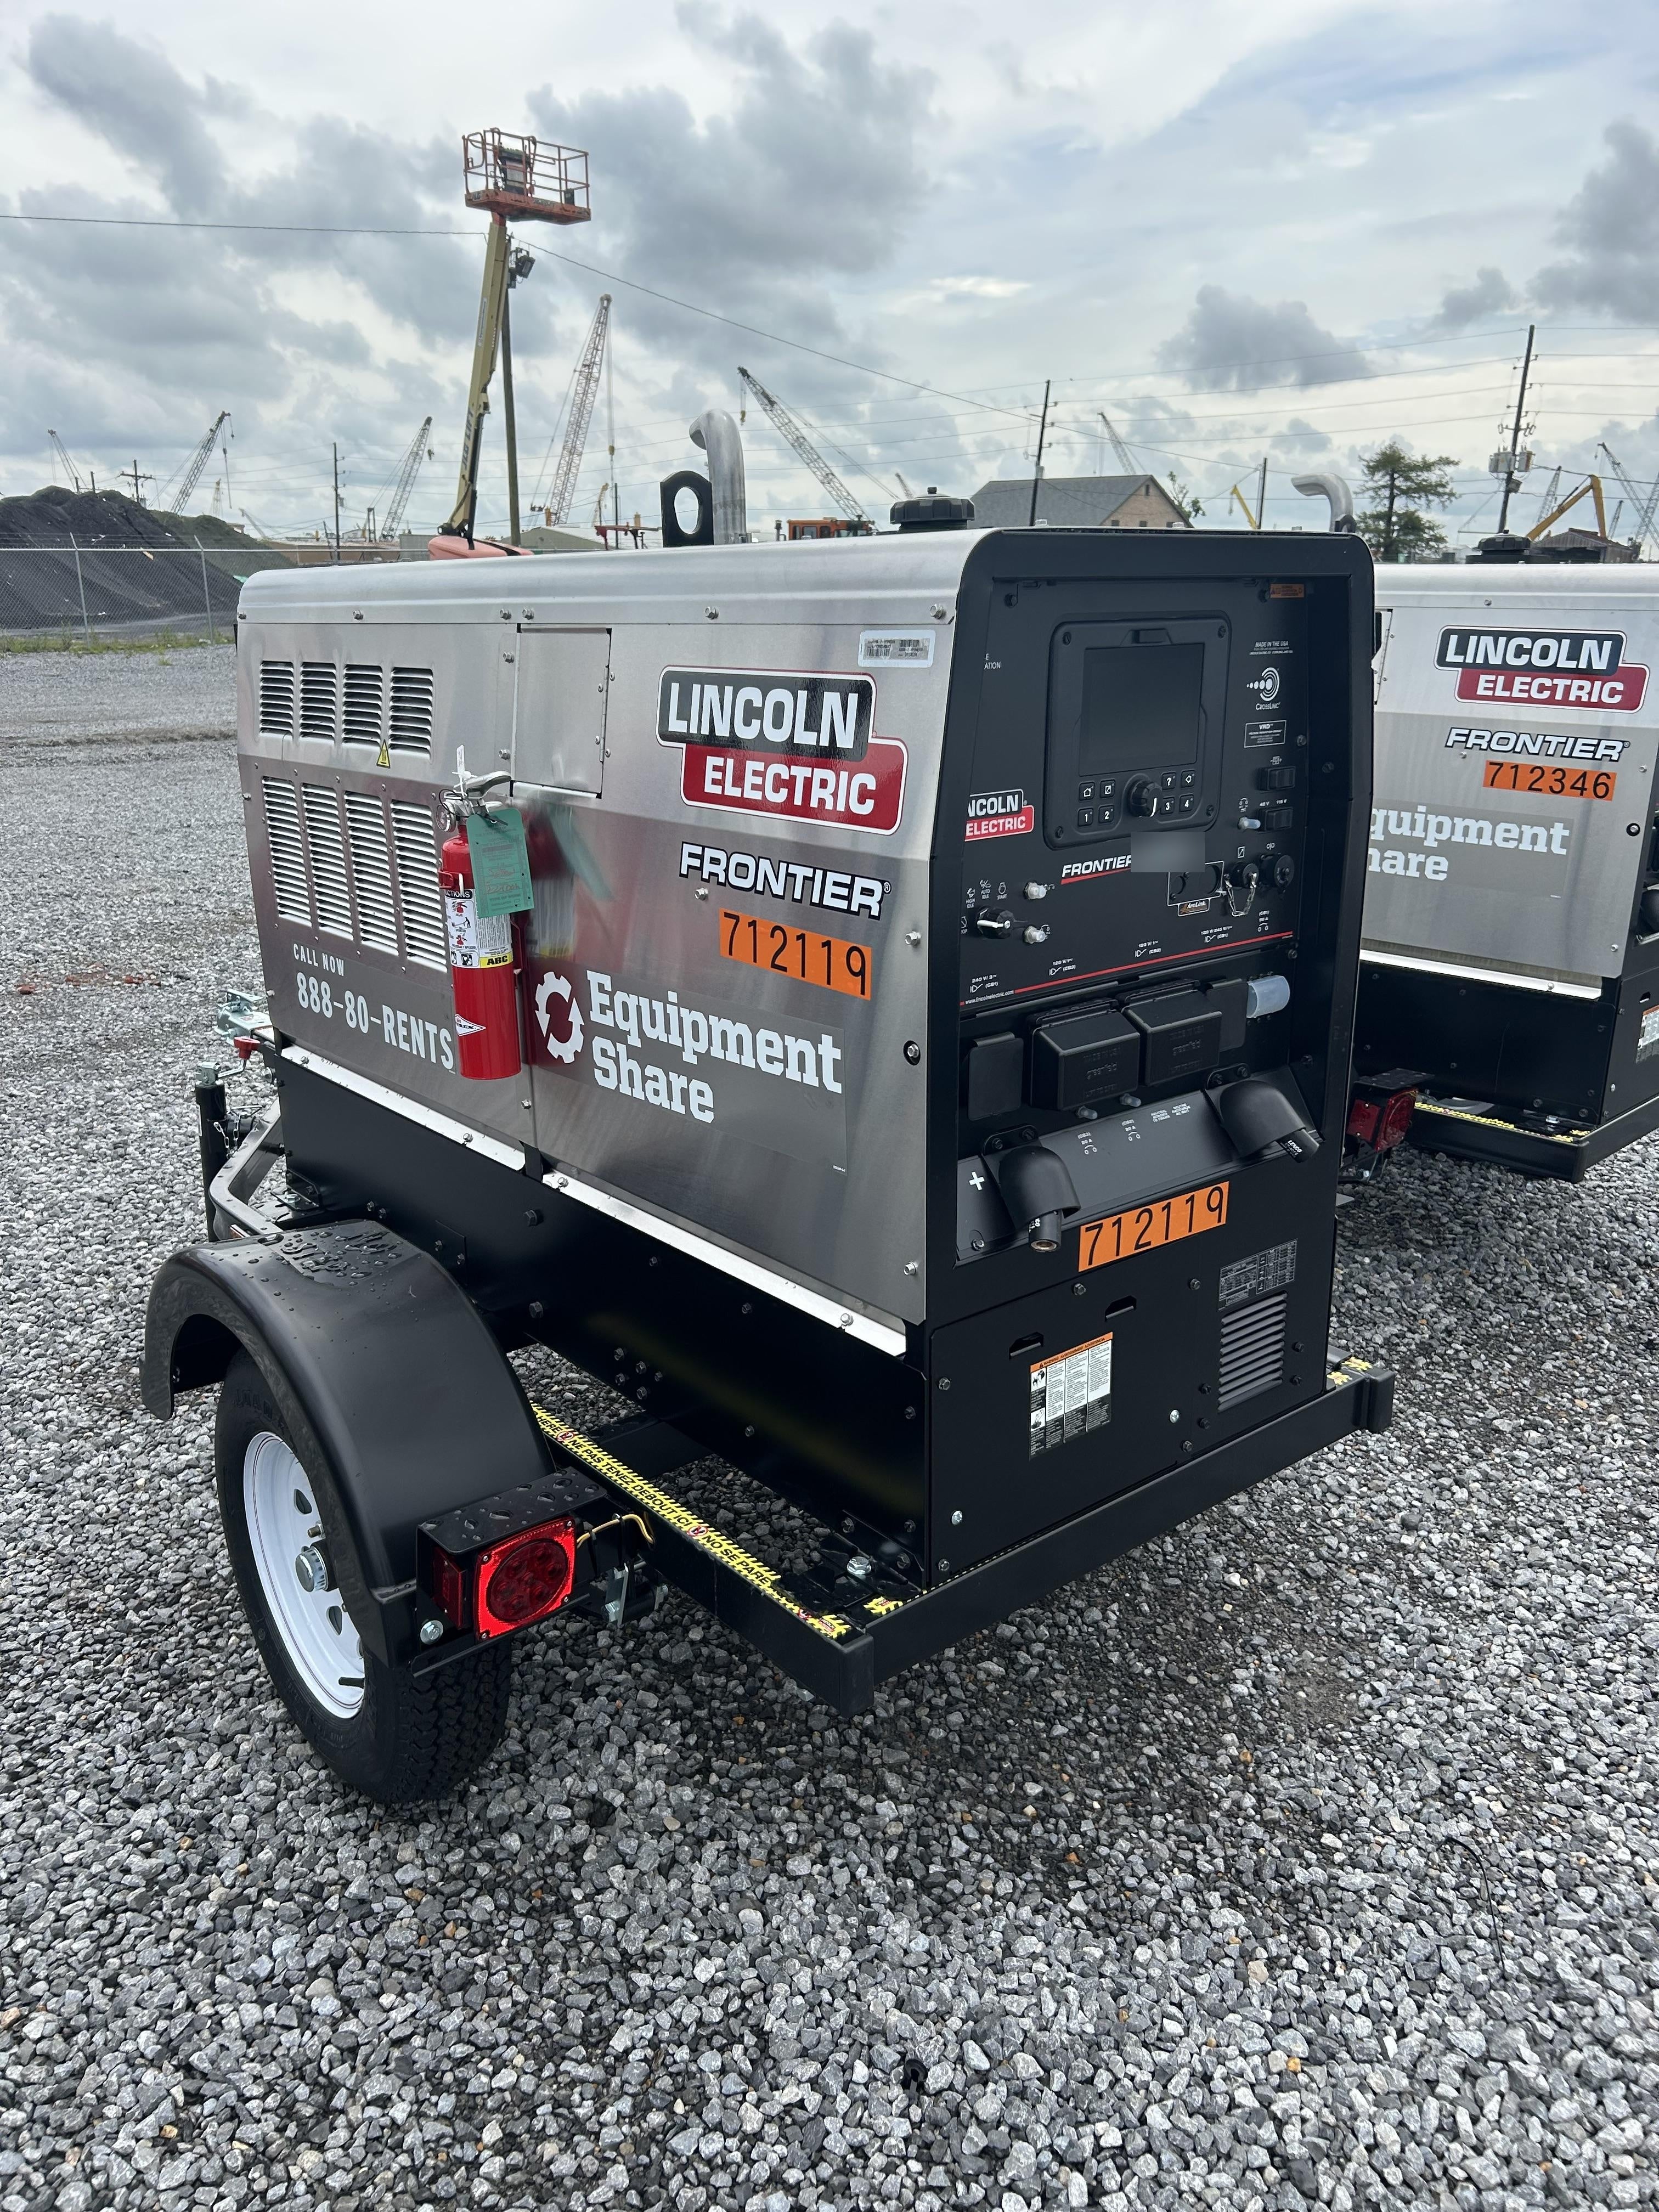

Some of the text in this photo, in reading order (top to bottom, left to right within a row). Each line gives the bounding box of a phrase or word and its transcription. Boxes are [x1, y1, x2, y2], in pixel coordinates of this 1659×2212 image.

[1446, 634, 1612, 670] LINCOLN
[1476, 674, 1623, 704] ELECTRIC
[668, 682, 859, 749] LINCOLN
[704, 755, 877, 816] ELECTRIC
[1488, 761, 1612, 799] 712346
[1084, 814, 1088, 822] 1
[1104, 810, 1109, 820] 2
[1165, 802, 1170, 811] 3
[1184, 799, 1189, 808] 4
[966, 816, 1026, 837] ELECTRIC
[1370, 805, 1570, 855] quipment
[293, 943, 345, 977] CALL NOW
[486, 955, 509, 966] ABC
[722, 912, 867, 996] 712119
[296, 972, 454, 1070] 888-80-RENTS
[586, 969, 842, 1094] Equipment
[591, 1035, 714, 1124] Share
[1084, 1185, 1225, 1266] 712119
[537, 1415, 563, 1434] HERE
[568, 1439, 693, 1527] NE PAS TENEZ DEBOUT ICI
[702, 1534, 770, 1586] NO SE PARE
